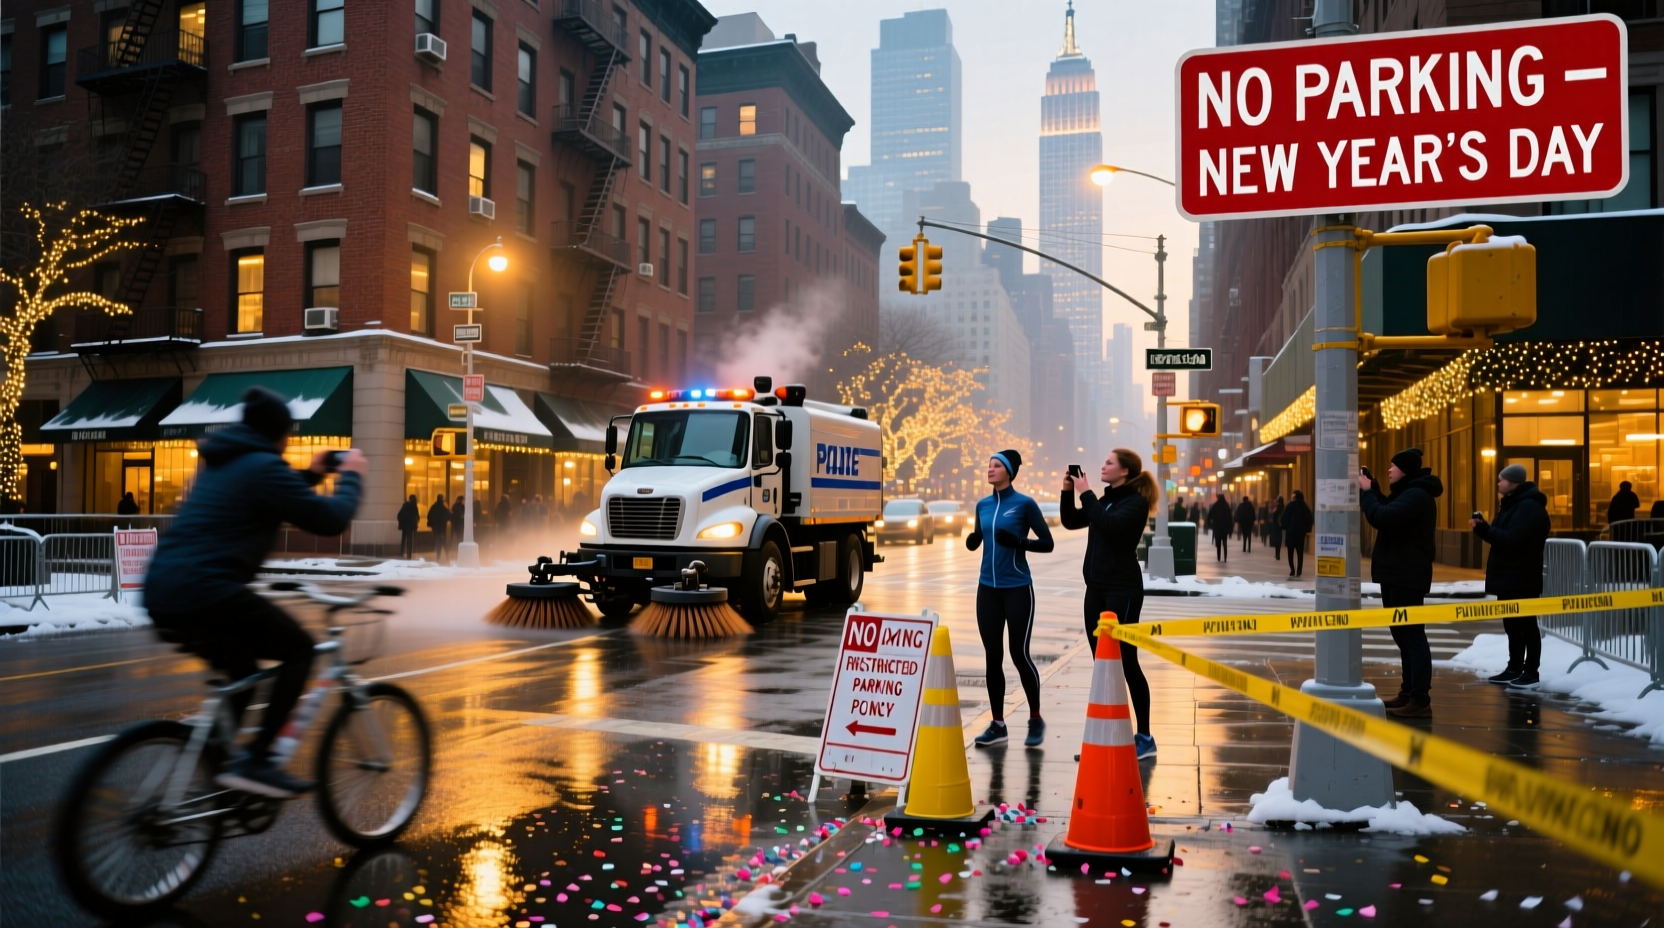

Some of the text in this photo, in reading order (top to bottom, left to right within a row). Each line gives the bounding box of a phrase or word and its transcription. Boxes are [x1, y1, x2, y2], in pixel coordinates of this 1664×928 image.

[1198, 67, 1272, 129] NO
[1295, 45, 1545, 122] PARKING
[1199, 123, 1604, 197] NEW YEAR'S DAY
[848, 621, 877, 647] NO
